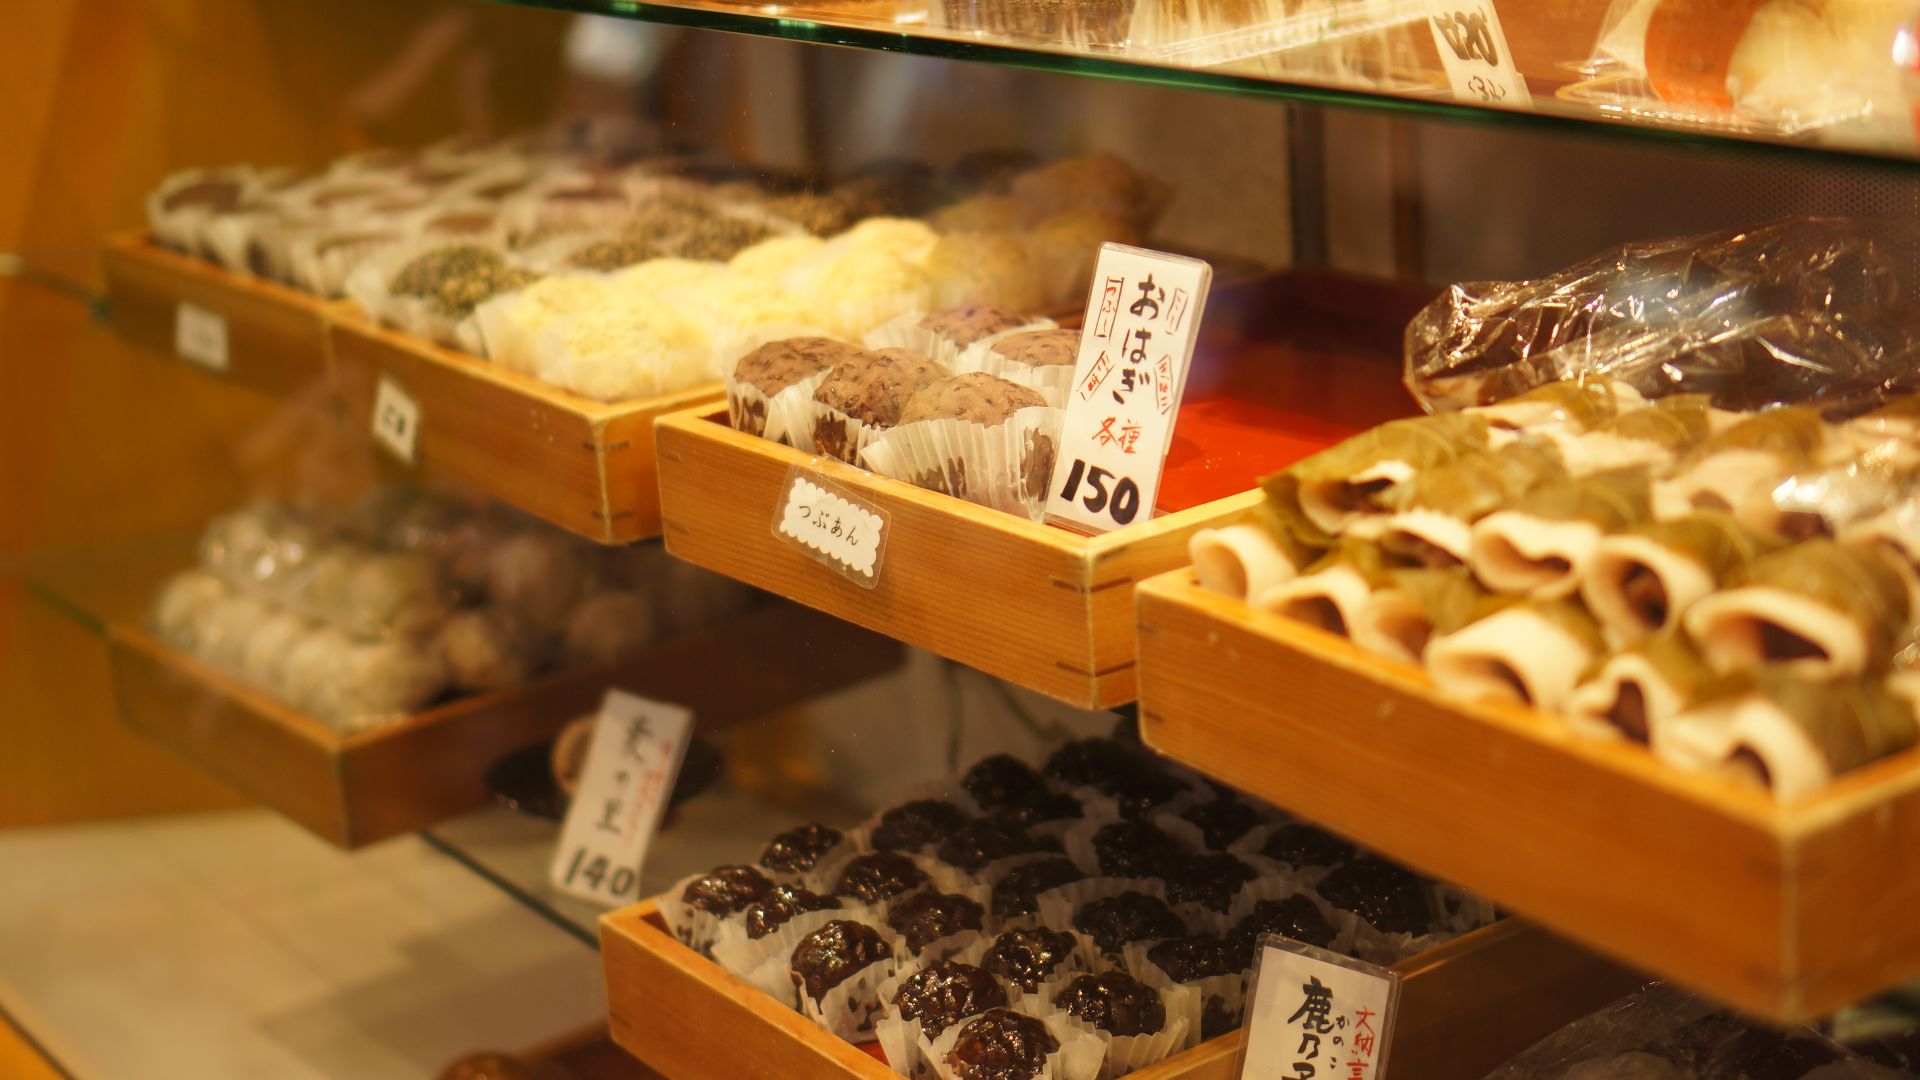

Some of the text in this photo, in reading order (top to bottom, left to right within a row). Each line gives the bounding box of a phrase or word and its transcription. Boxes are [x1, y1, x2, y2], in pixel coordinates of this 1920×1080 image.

[1112, 273, 1166, 404] おはぎ
[1092, 416, 1142, 454] 各種
[1060, 458, 1140, 525] 150
[798, 504, 859, 546] つぶあん
[564, 844, 636, 896] 140
[1329, 1015, 1350, 1070] かのこ
